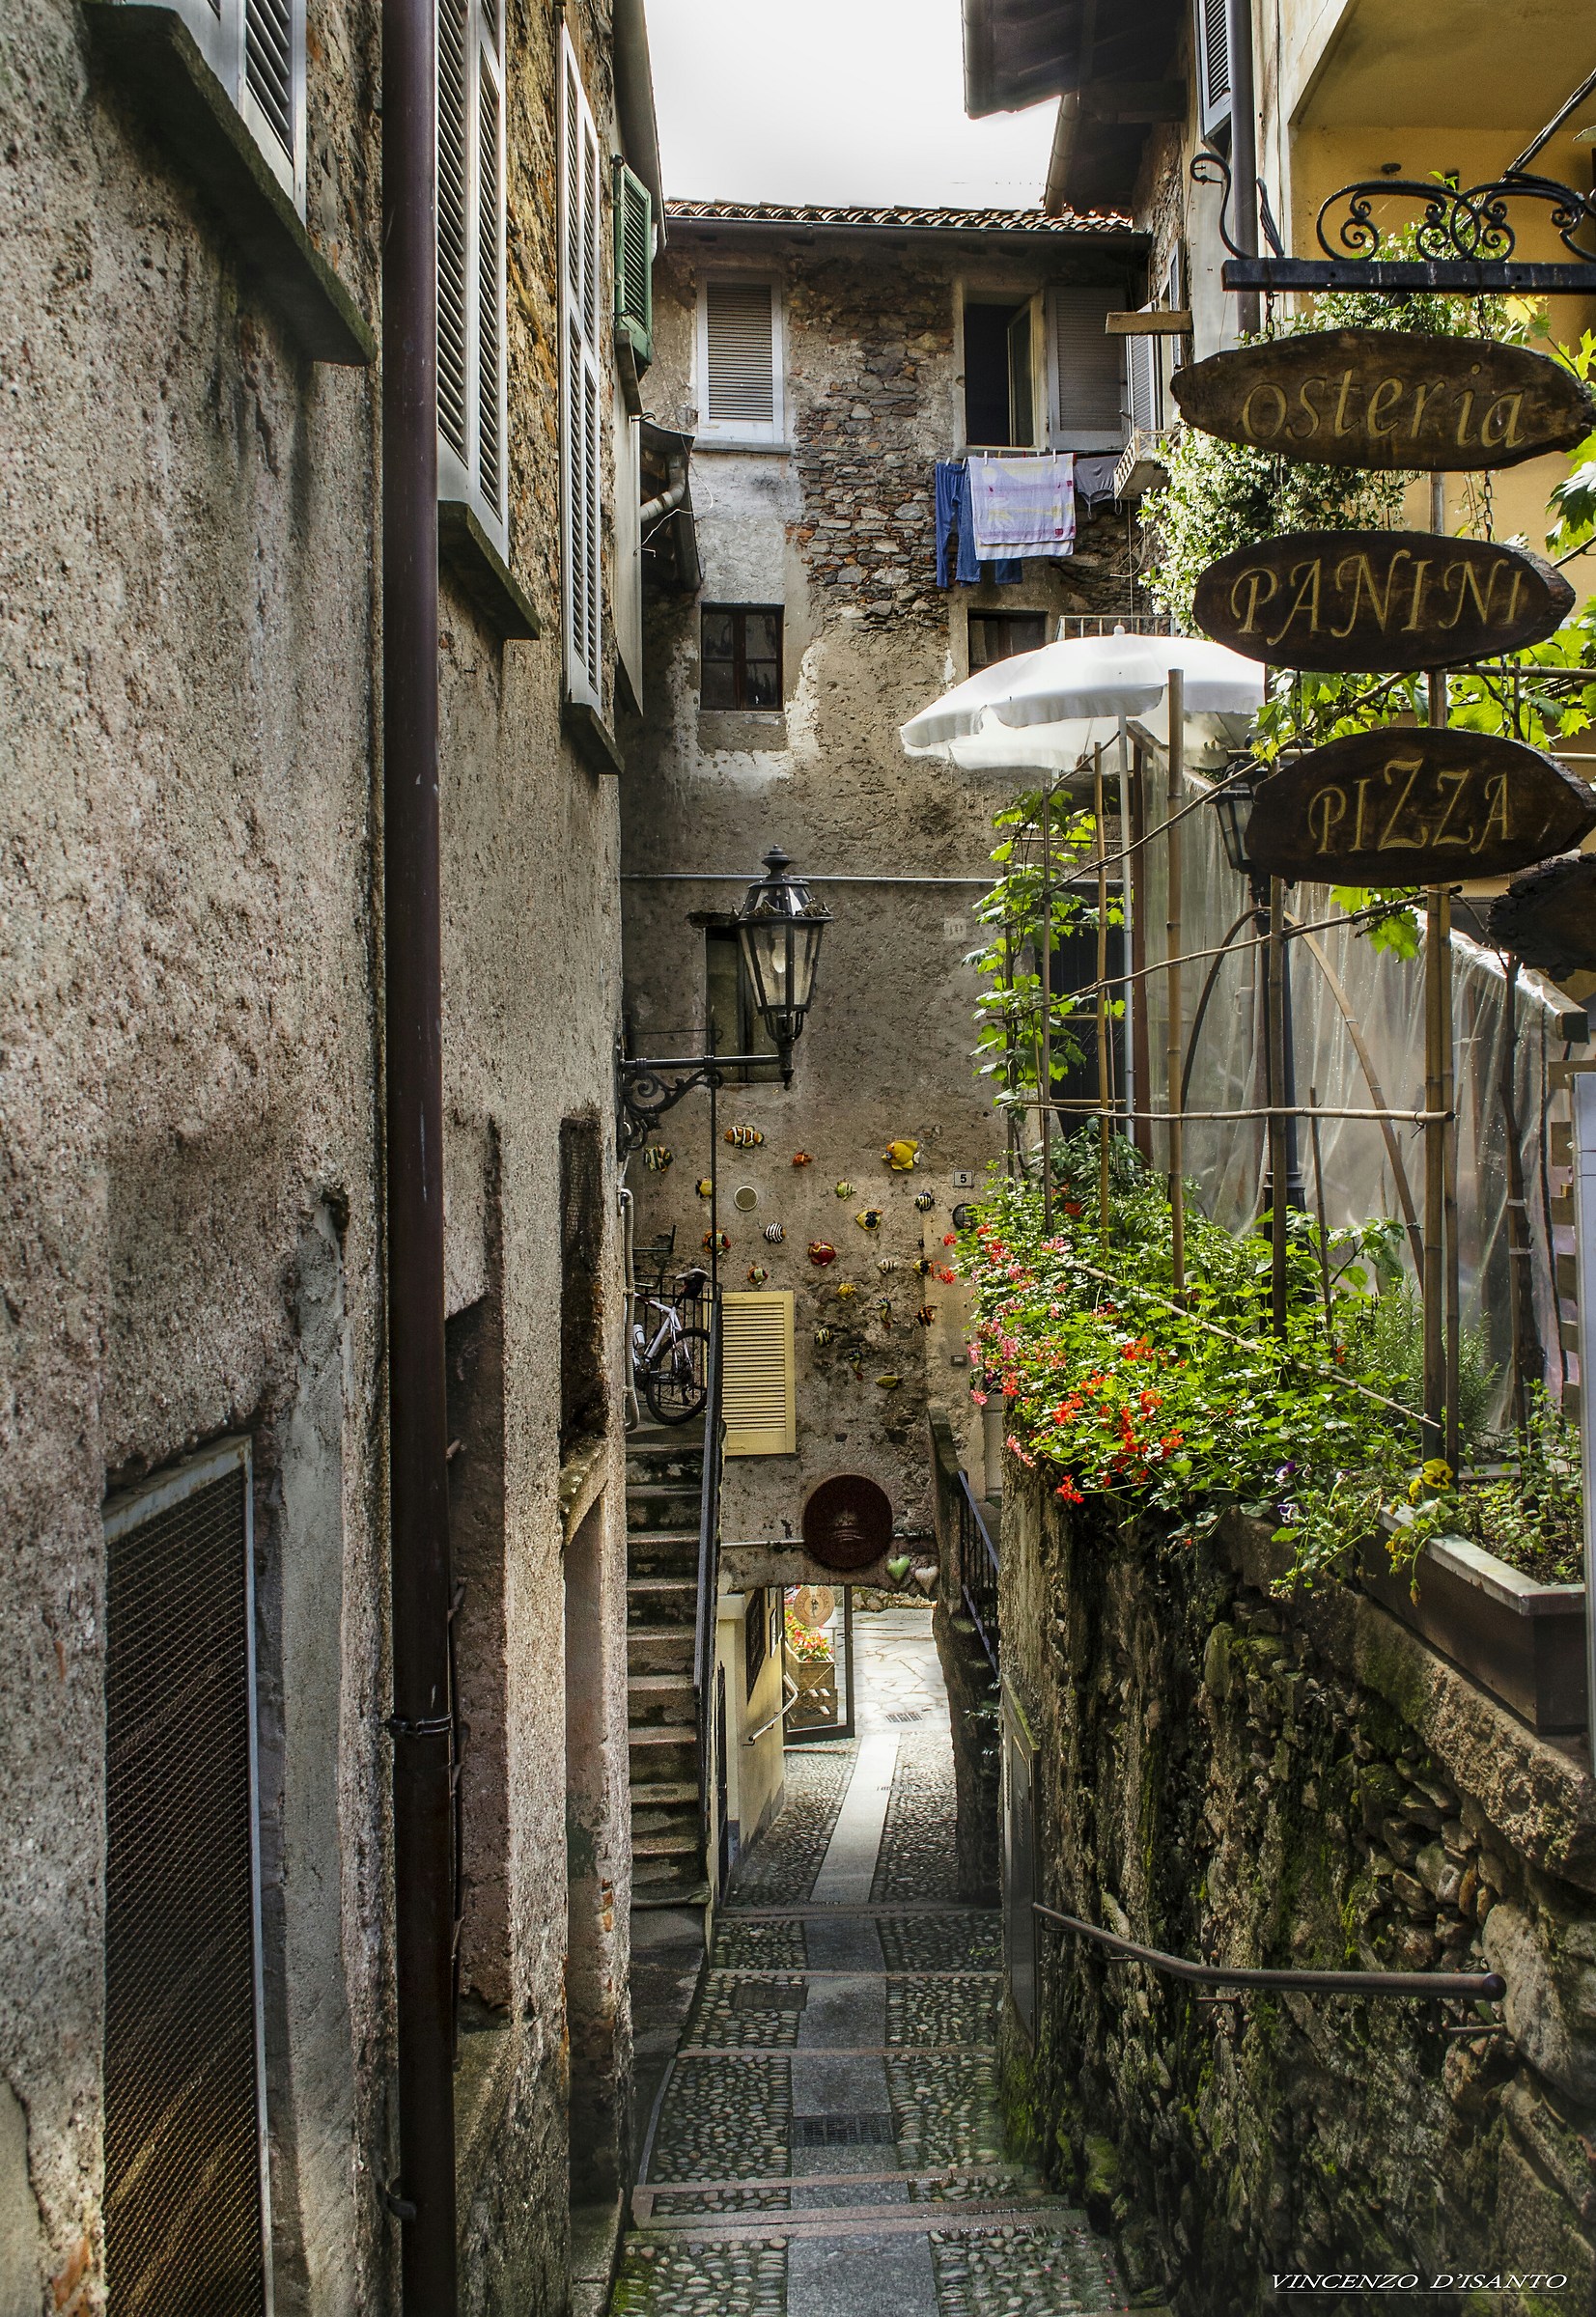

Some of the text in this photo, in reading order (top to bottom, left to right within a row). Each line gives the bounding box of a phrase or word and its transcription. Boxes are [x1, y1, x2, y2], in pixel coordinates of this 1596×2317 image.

[1230, 549, 1523, 646] PANINI
[1308, 758, 1514, 855] PIZZA
[960, 1173, 967, 1184] 5
